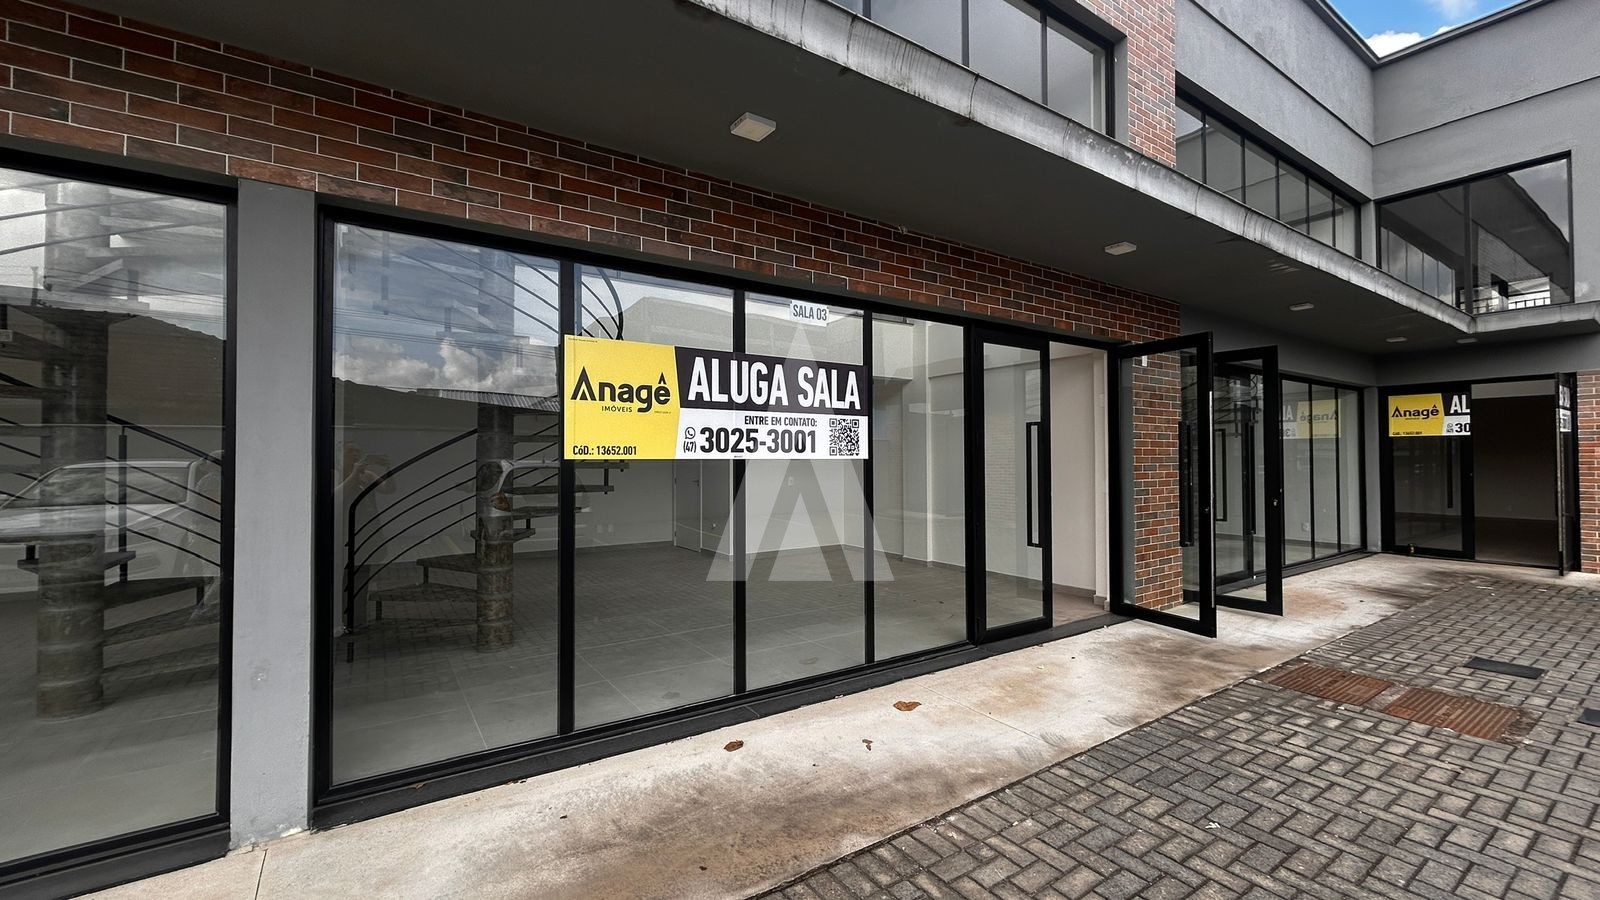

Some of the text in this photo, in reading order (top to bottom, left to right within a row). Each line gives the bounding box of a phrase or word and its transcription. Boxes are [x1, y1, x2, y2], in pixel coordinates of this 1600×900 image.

[793, 304, 828, 321] SALA 03
[571, 366, 671, 413] Anagê
[687, 356, 861, 410] ALUGA SALA
[601, 405, 633, 413] IMÓVEIS
[1391, 404, 1440, 420] Anagê
[1449, 394, 1471, 414] AL
[744, 415, 818, 427] ENTRE EM CONTATO:
[1455, 422, 1471, 433] 30
[683, 427, 816, 454] (47) 3025-3001
[596, 445, 637, 456] 13652.001
